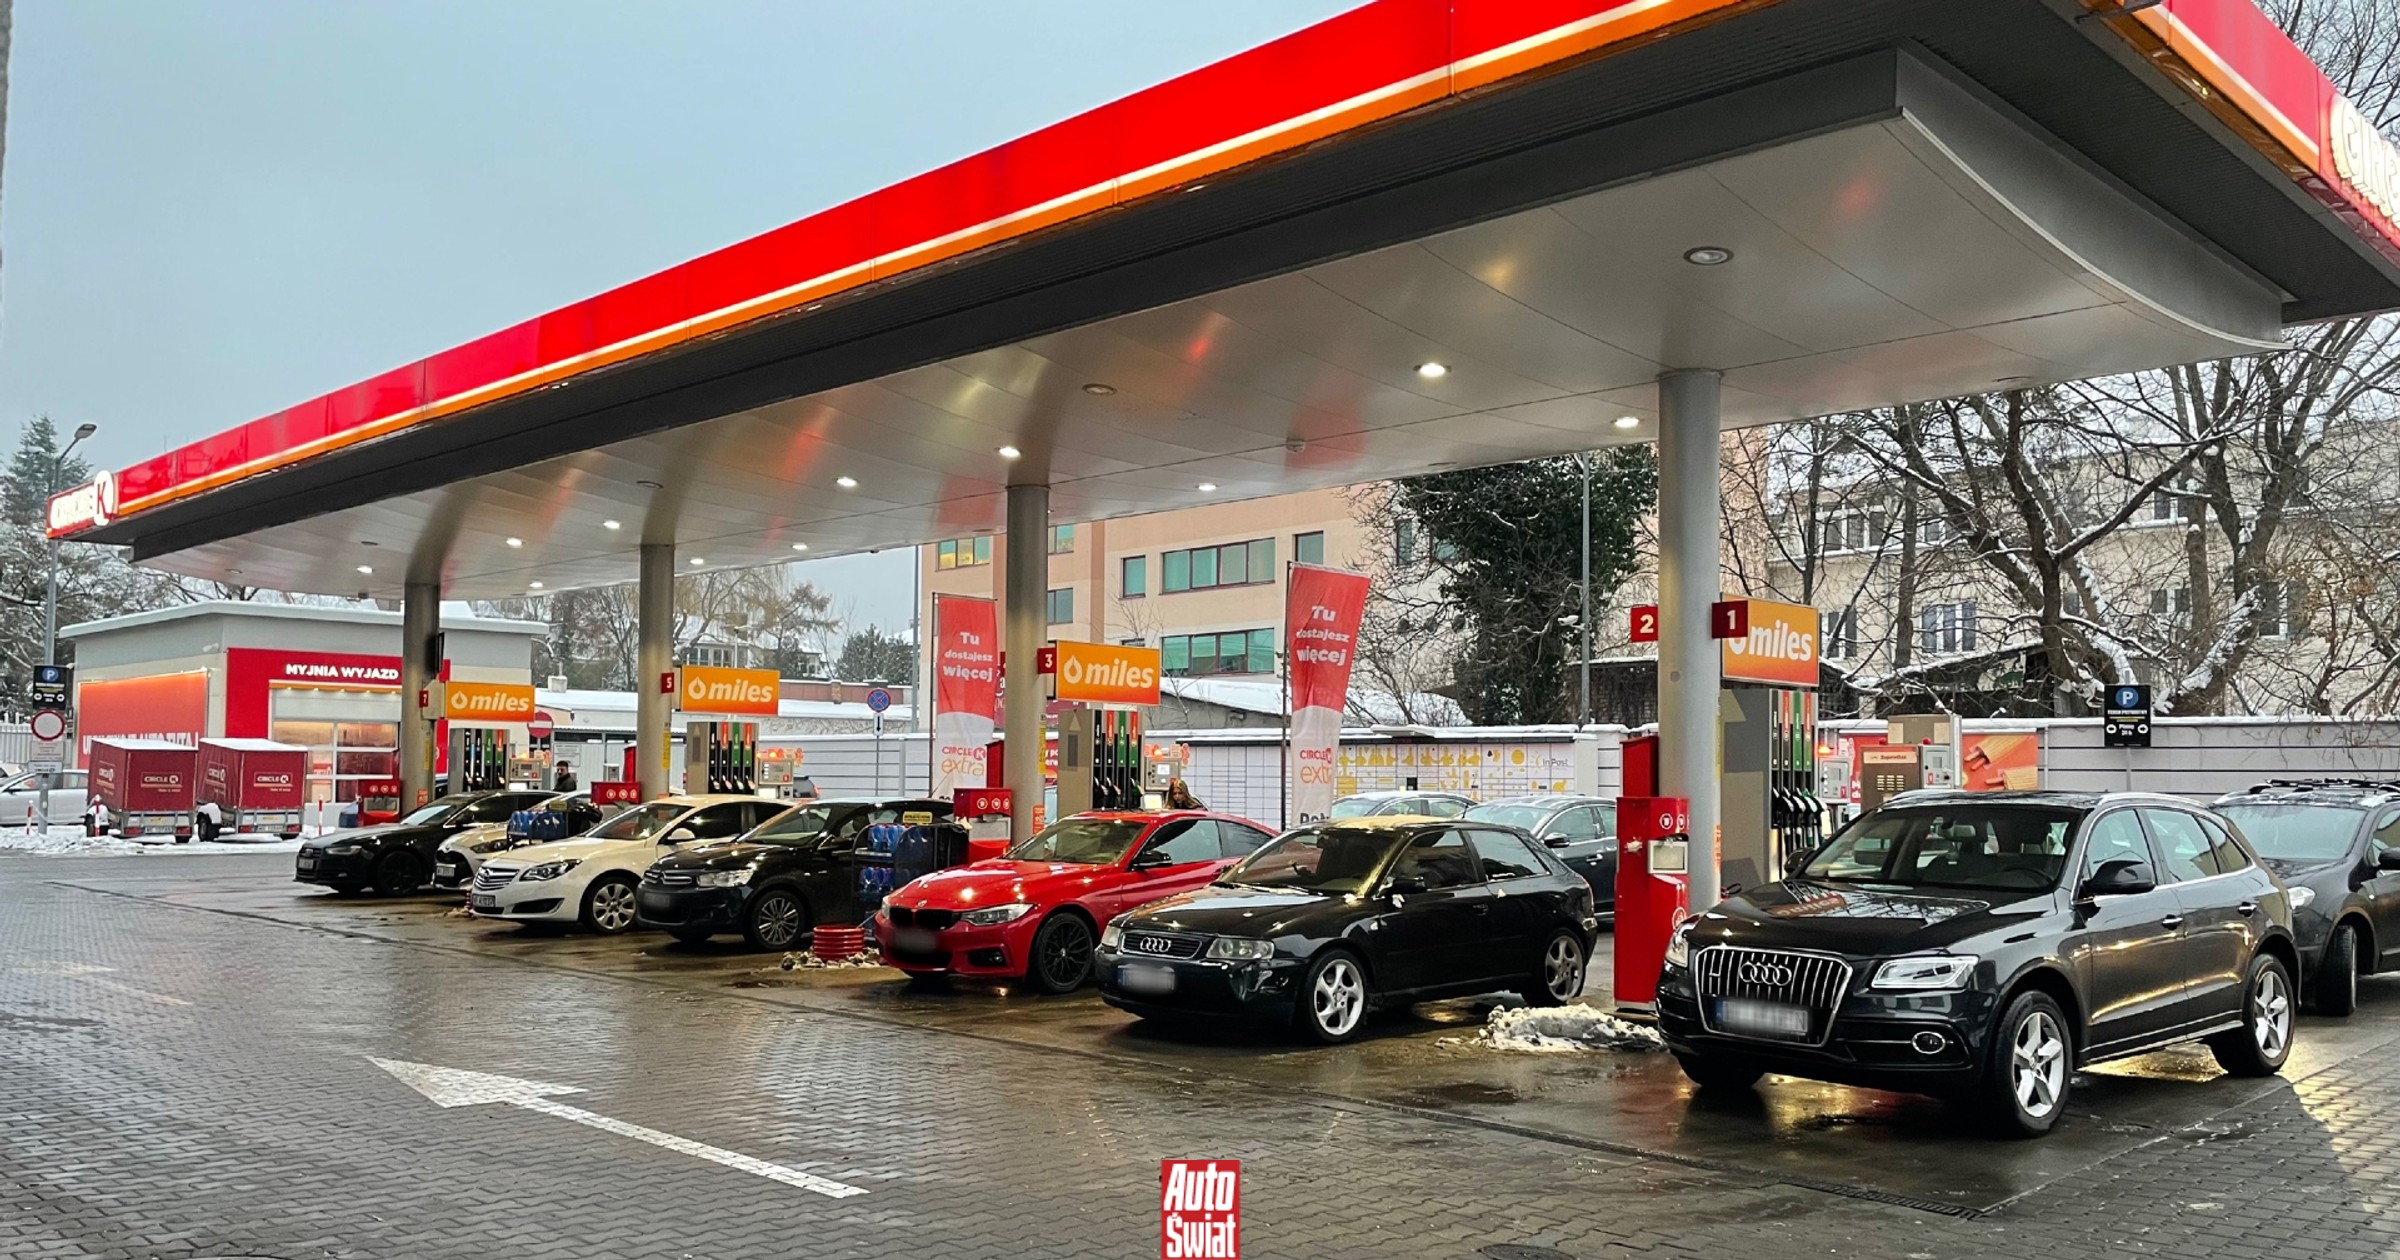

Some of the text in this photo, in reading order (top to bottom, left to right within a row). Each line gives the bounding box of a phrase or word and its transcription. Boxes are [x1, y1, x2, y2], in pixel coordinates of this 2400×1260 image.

[1312, 604, 1336, 622] Tu
[1727, 610, 1736, 630] 1
[1640, 614, 1654, 634] 2
[960, 632, 980, 645] Tu
[1749, 619, 1813, 661] miles
[944, 649, 993, 662] dostajesz
[1045, 653, 1053, 668] 3
[286, 664, 399, 680] MYJNIA WYJAZD
[943, 665, 993, 682] więcej
[1084, 658, 1155, 688] miles
[708, 679, 773, 702] miles
[2123, 691, 2133, 705] P
[470, 692, 530, 712] miles
[942, 747, 973, 757] CIRCLE
[941, 756, 985, 777] extra
